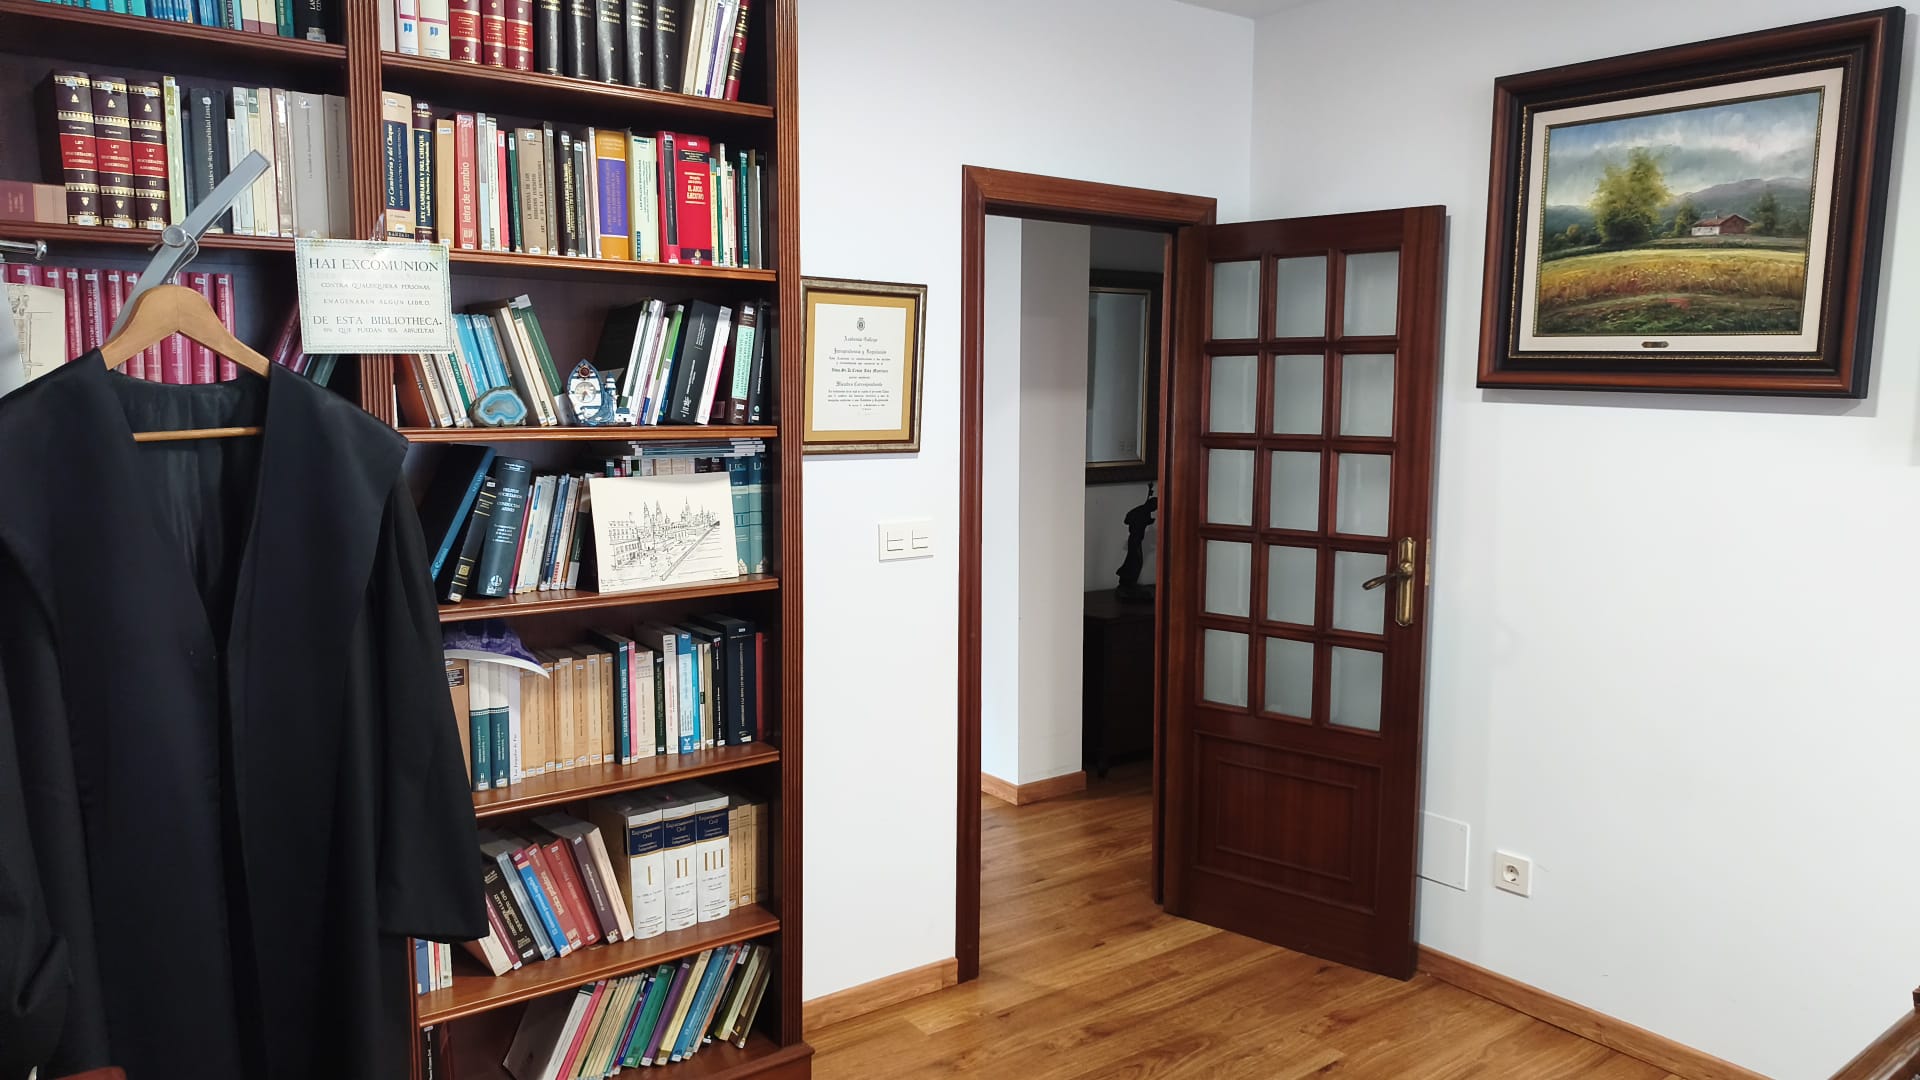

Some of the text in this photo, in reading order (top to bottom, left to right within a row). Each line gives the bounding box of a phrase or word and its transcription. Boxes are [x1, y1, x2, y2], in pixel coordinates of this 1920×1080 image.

[460, 161, 470, 191] cambio
[461, 205, 471, 222] letra
[309, 257, 439, 272] HAI EXCOMUNION
[313, 315, 443, 326] DE ESTA BIBLIOTHECA.
[676, 857, 688, 878] II
[704, 848, 724, 871] III
